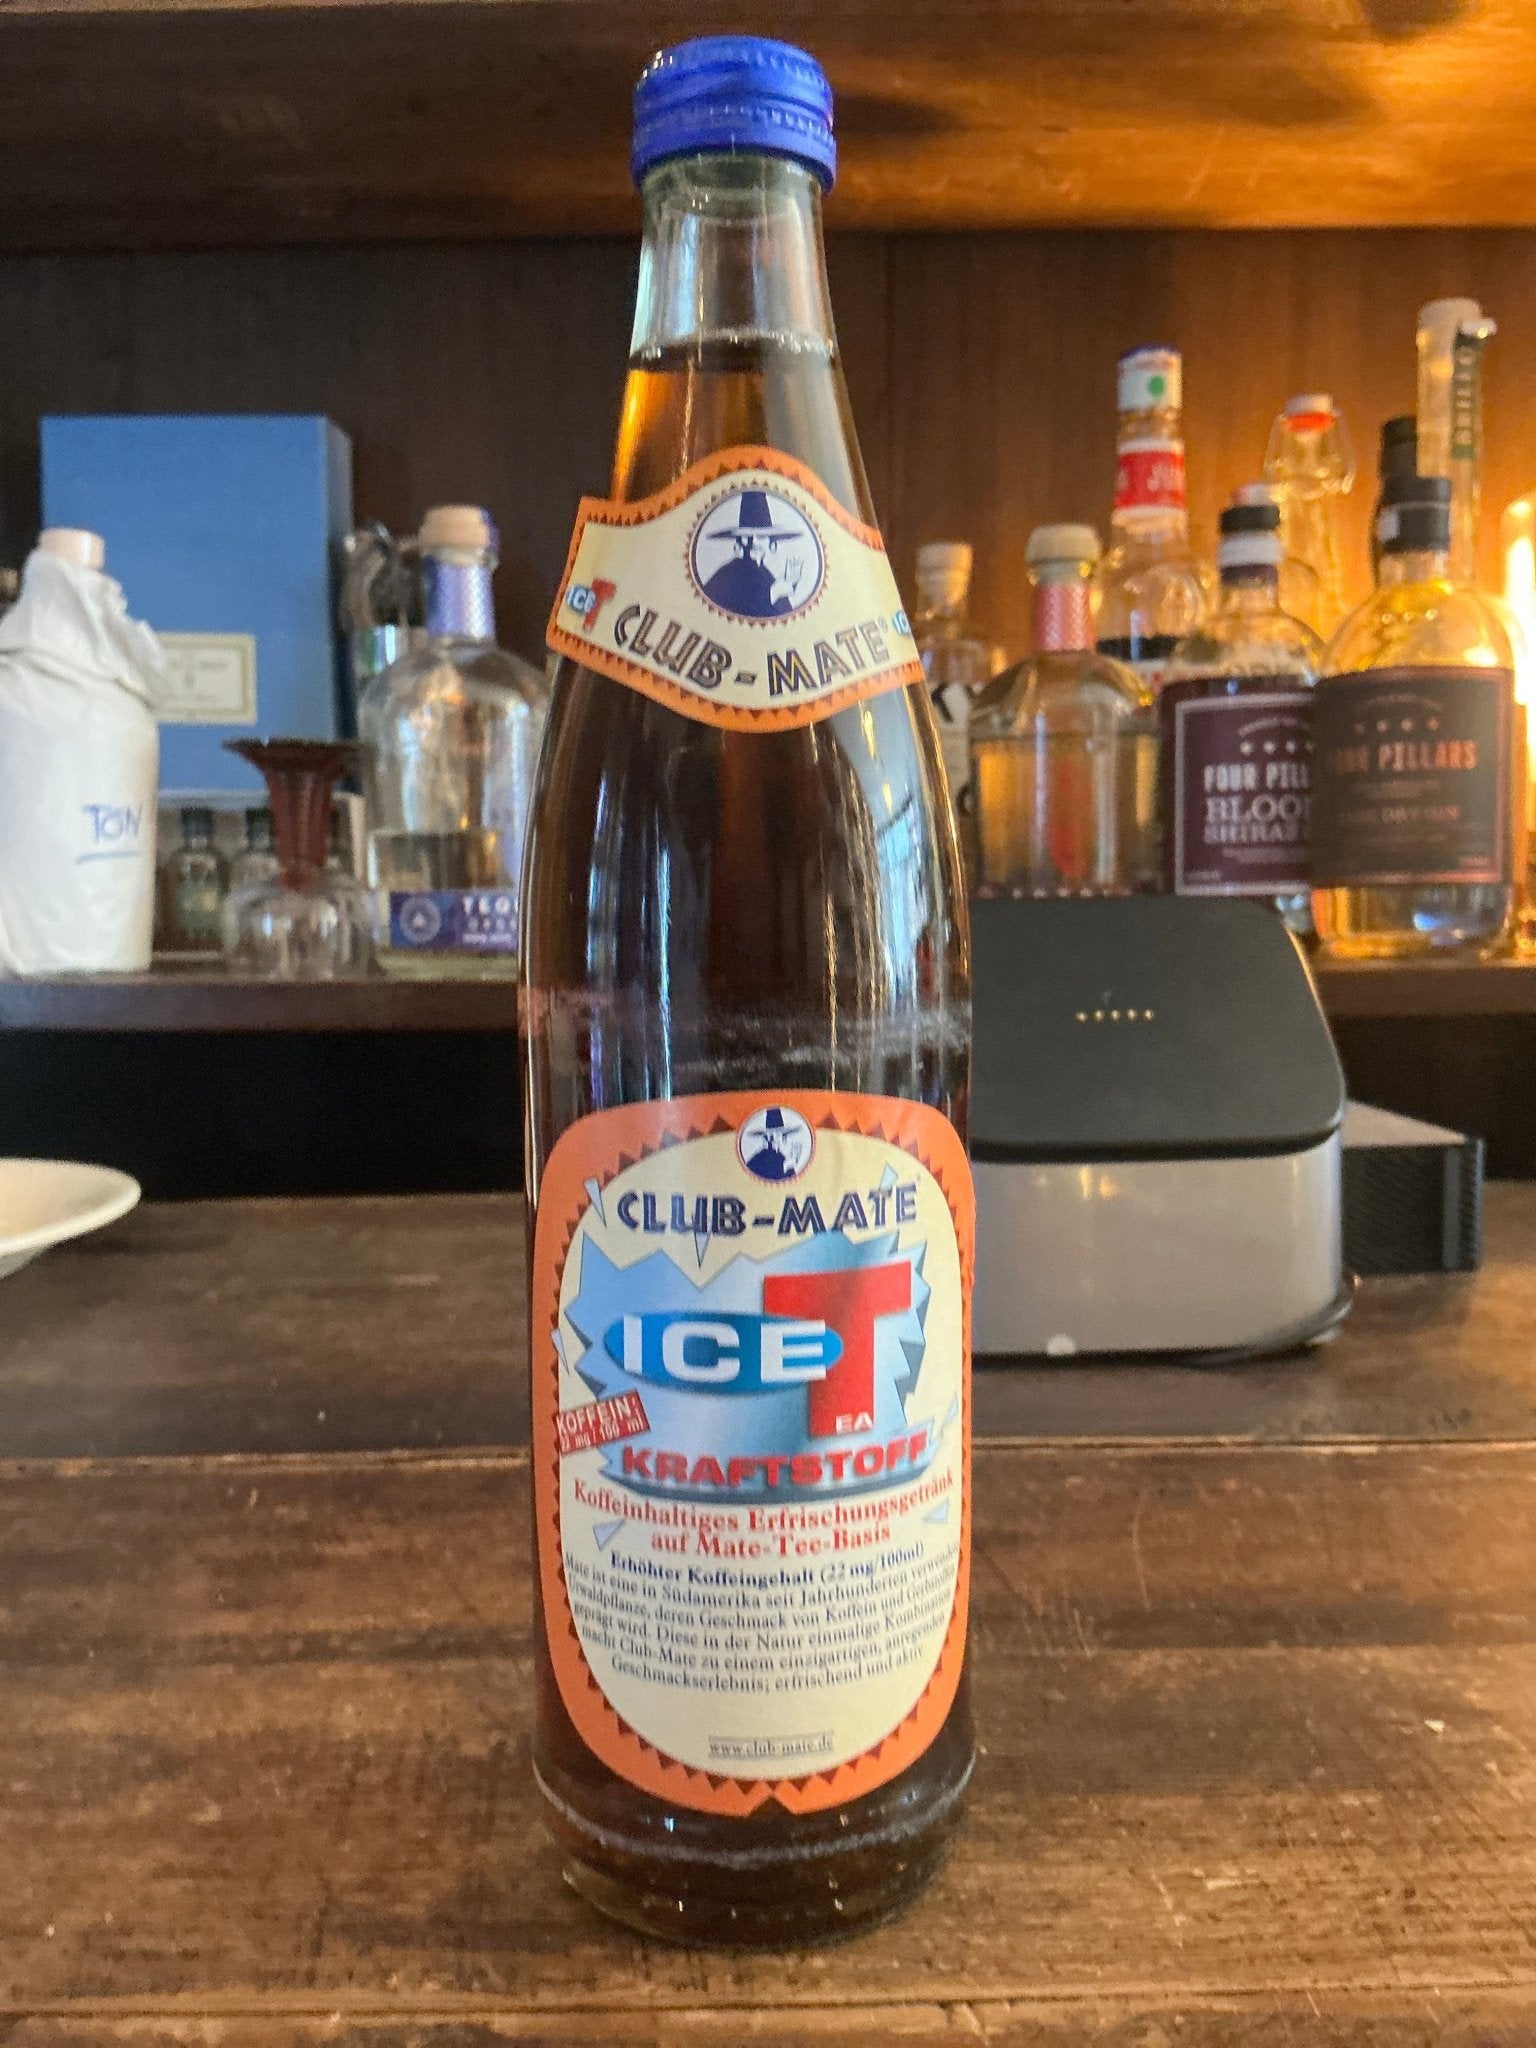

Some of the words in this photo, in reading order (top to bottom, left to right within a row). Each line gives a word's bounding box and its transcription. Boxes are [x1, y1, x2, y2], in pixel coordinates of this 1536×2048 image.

[616, 1184, 918, 1239] CLUB-MATE
[623, 1313, 827, 1385] ICE
[621, 1429, 931, 1488] KRAFTSTOFF
[574, 1478, 739, 1535] Koffeinhaltiges
[748, 1466, 954, 1533] Erfrischungsgetränk
[652, 1531, 689, 1553] auf
[697, 1524, 891, 1558] Mate-Tee-Basis
[611, 1551, 682, 1582] Erhöhter
[687, 1566, 814, 1591] Koffeingehalt
[699, 1609, 786, 1629] Geschmack
[724, 1632, 751, 1651] der
[756, 1633, 802, 1652] Natur
[724, 1654, 774, 1672] einem
